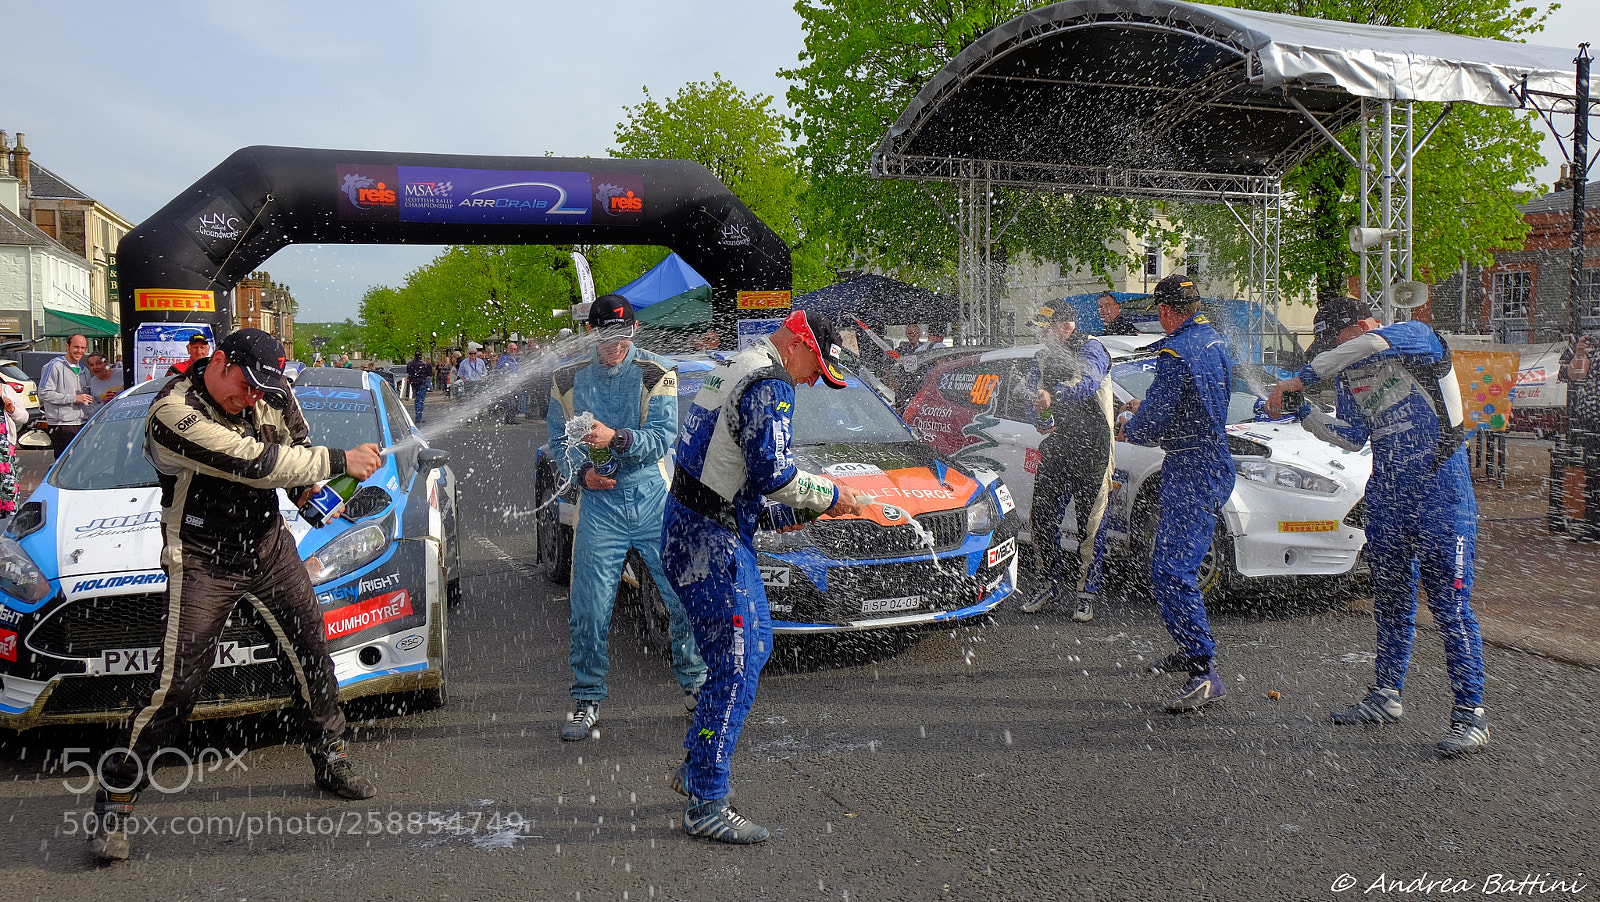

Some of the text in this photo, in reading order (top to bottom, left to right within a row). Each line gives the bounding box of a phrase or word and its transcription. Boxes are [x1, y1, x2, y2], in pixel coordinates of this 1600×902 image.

[359, 182, 396, 203] reis
[405, 184, 434, 197] MSA
[611, 190, 642, 209] reis
[109, 256, 116, 265] B
[111, 281, 117, 289] B
[139, 292, 210, 309] PIRELLI
[970, 374, 1000, 405] 407
[919, 403, 953, 418] Scottish
[835, 463, 867, 471] 401
[1283, 521, 1334, 532] PIRELLI
[71, 574, 168, 594] HOLMPARK
[871, 598, 918, 610] SP 04-03
[327, 603, 400, 635] KUMHO TYRE
[400, 637, 419, 646] RSC
